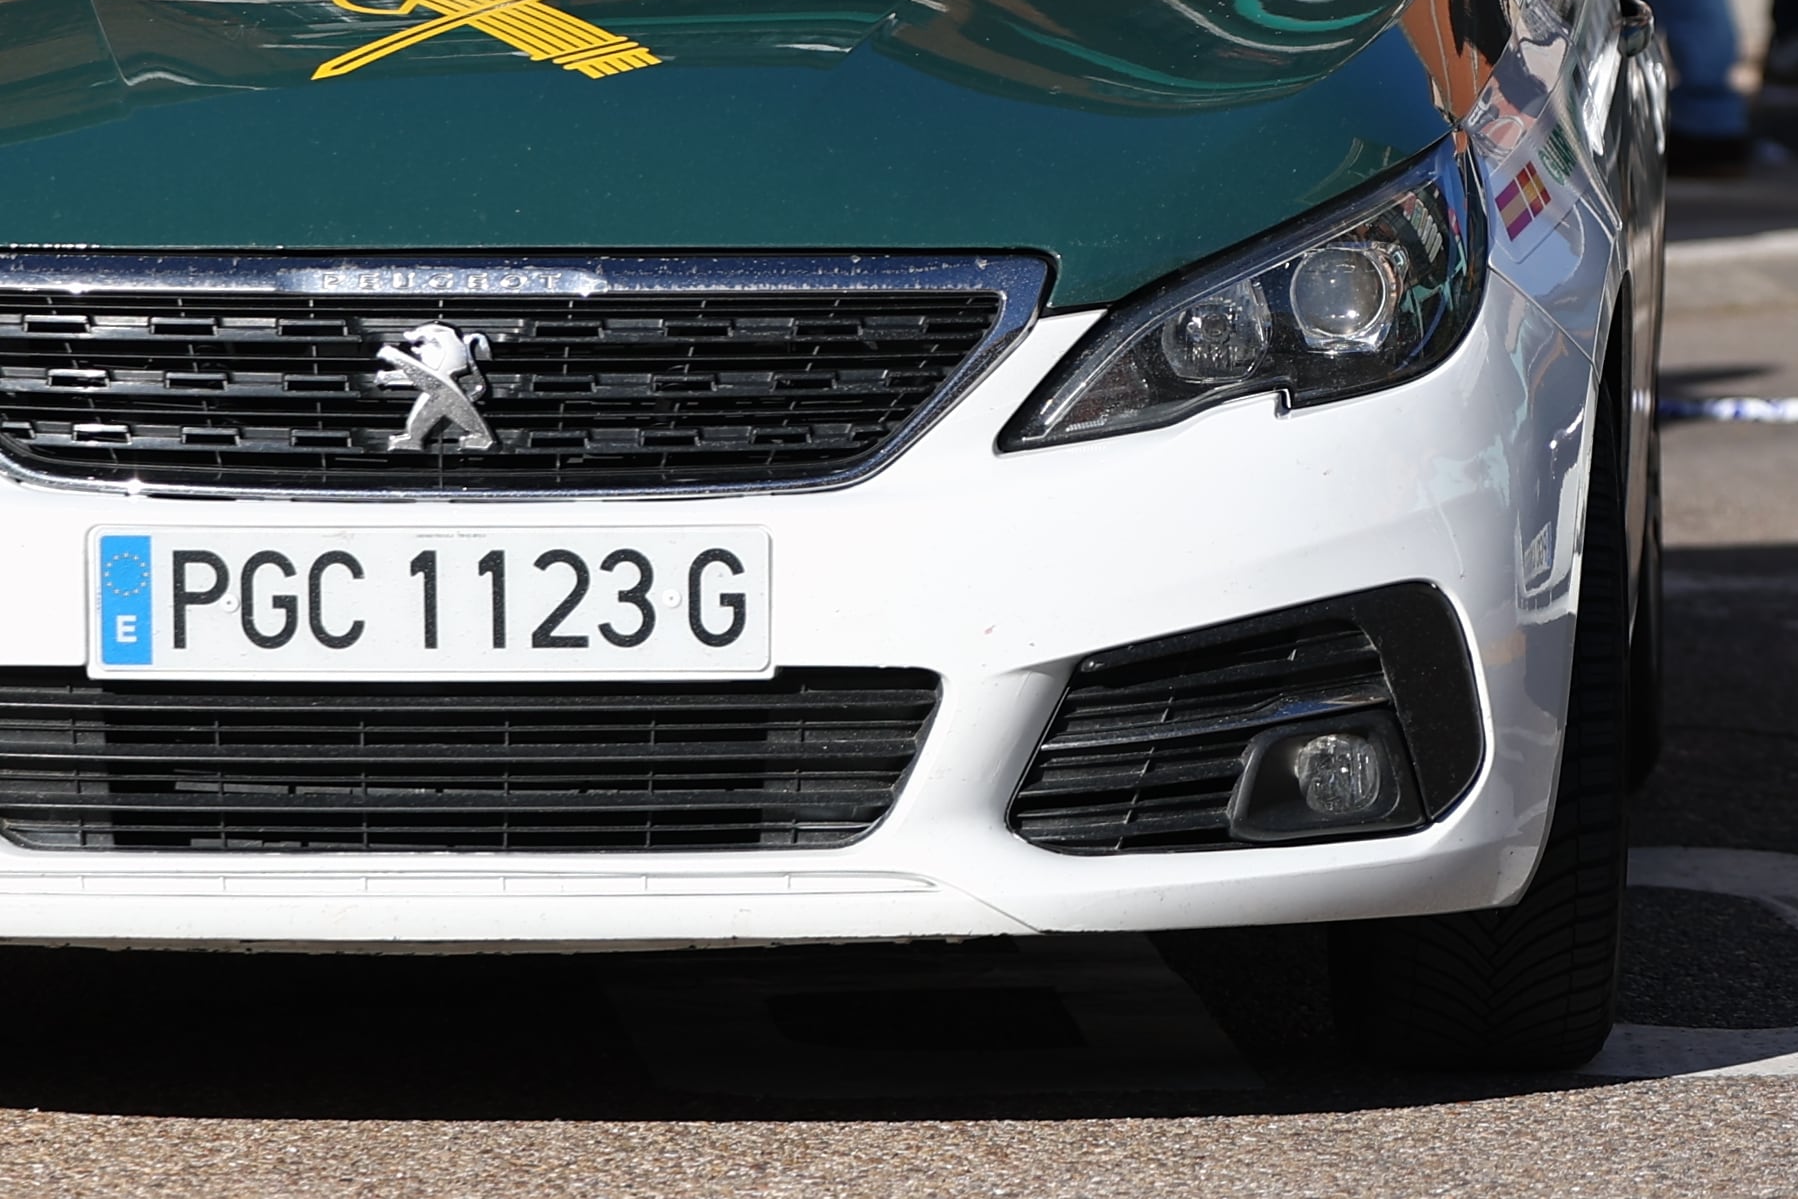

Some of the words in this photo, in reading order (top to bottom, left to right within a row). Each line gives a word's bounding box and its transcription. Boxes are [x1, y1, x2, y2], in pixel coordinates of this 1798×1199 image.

[321, 272, 562, 290] PEUGEOT
[115, 614, 138, 643] E
[171, 548, 366, 650] PGC
